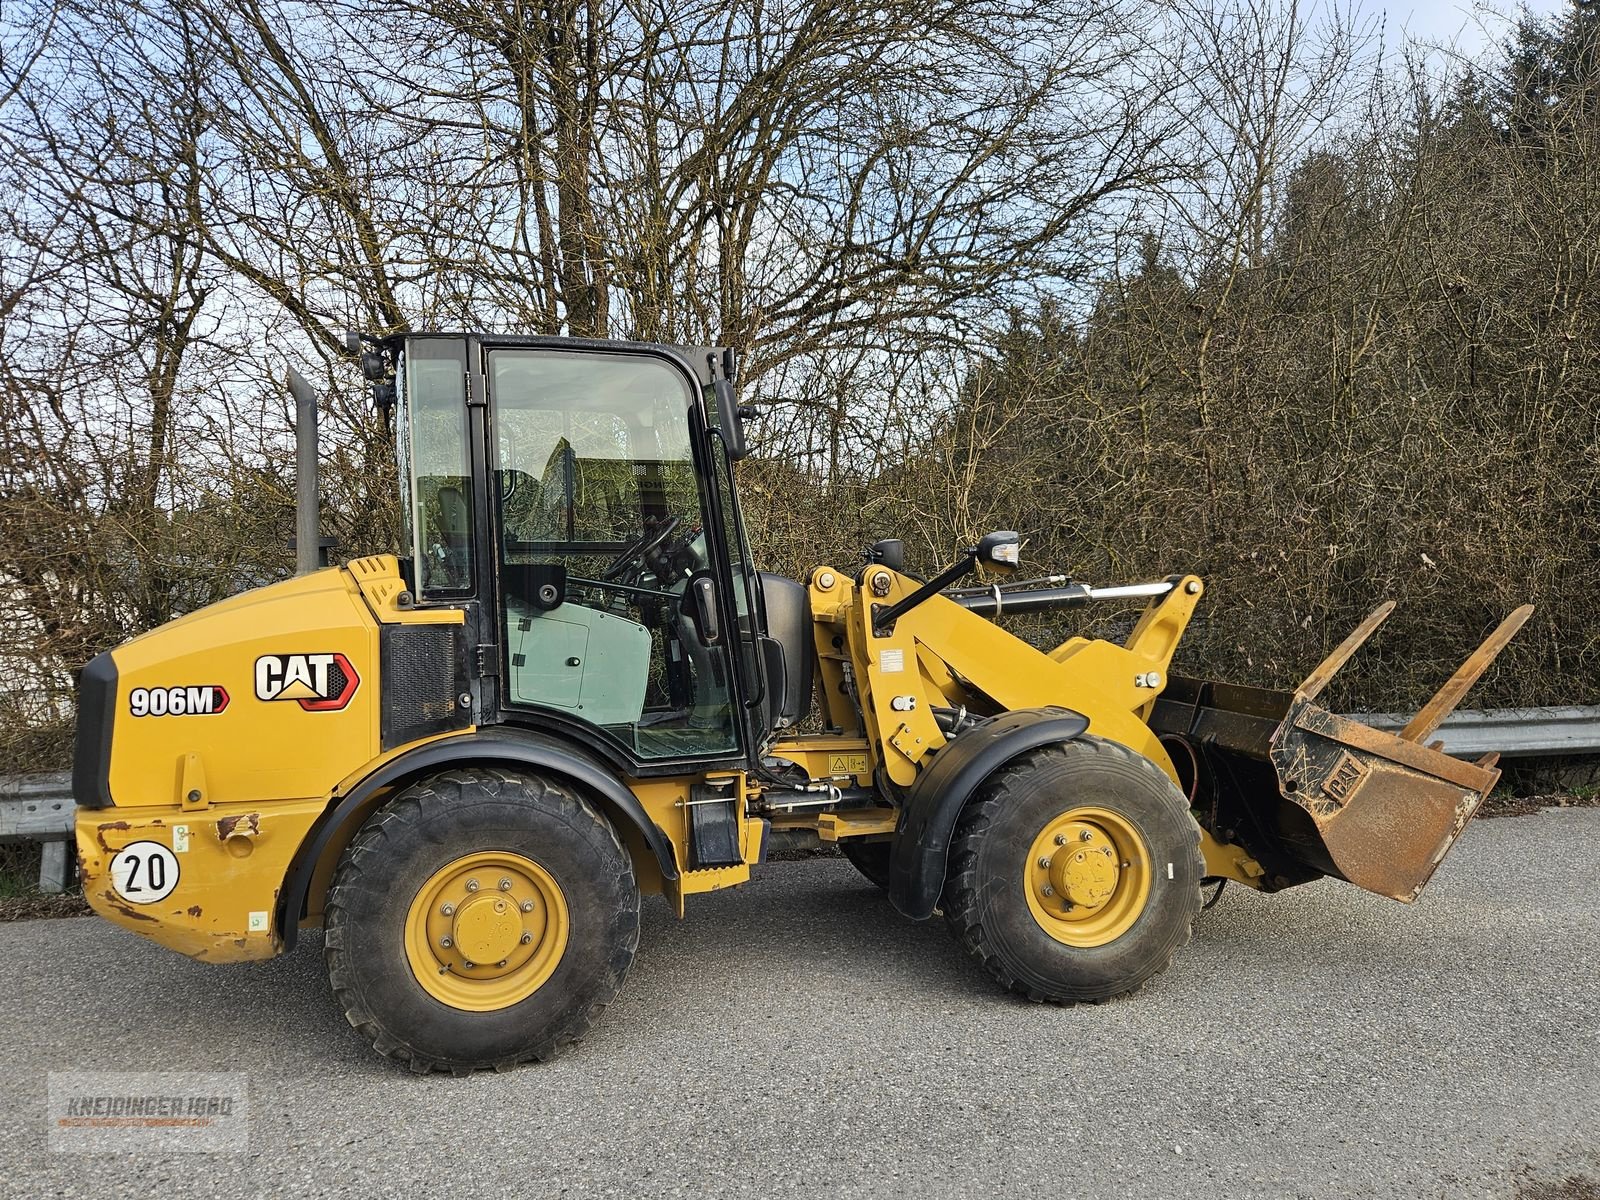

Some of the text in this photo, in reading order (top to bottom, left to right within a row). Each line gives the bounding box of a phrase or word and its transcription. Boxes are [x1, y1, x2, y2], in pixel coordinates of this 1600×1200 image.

[255, 654, 334, 700] CAT
[131, 686, 213, 716] 906M
[1328, 758, 1361, 799] CAT
[124, 853, 165, 892] 20
